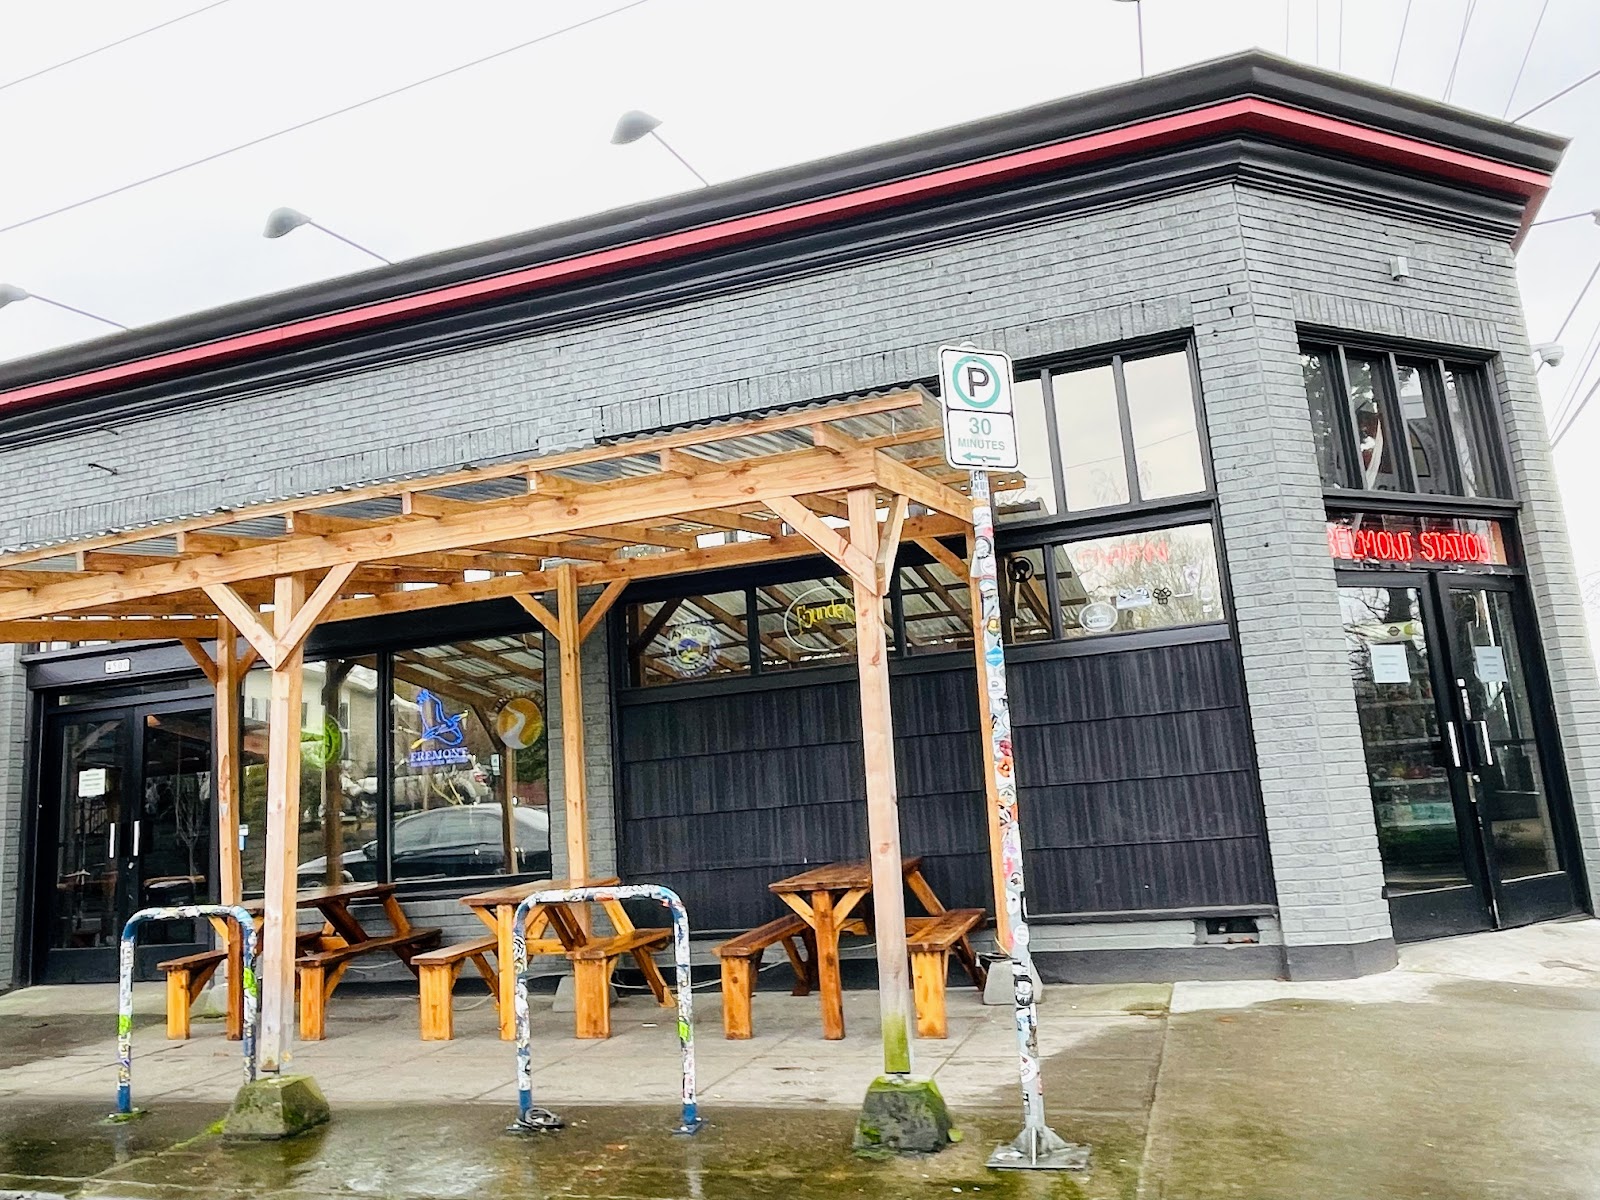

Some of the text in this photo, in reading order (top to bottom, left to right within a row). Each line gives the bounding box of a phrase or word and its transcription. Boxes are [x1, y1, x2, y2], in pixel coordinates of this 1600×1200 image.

[967, 366, 990, 397] P
[969, 417, 992, 435] 30
[957, 437, 1006, 451] MINUTES
[1420, 530, 1492, 561] STATION
[410, 747, 468, 762] FREMONT
